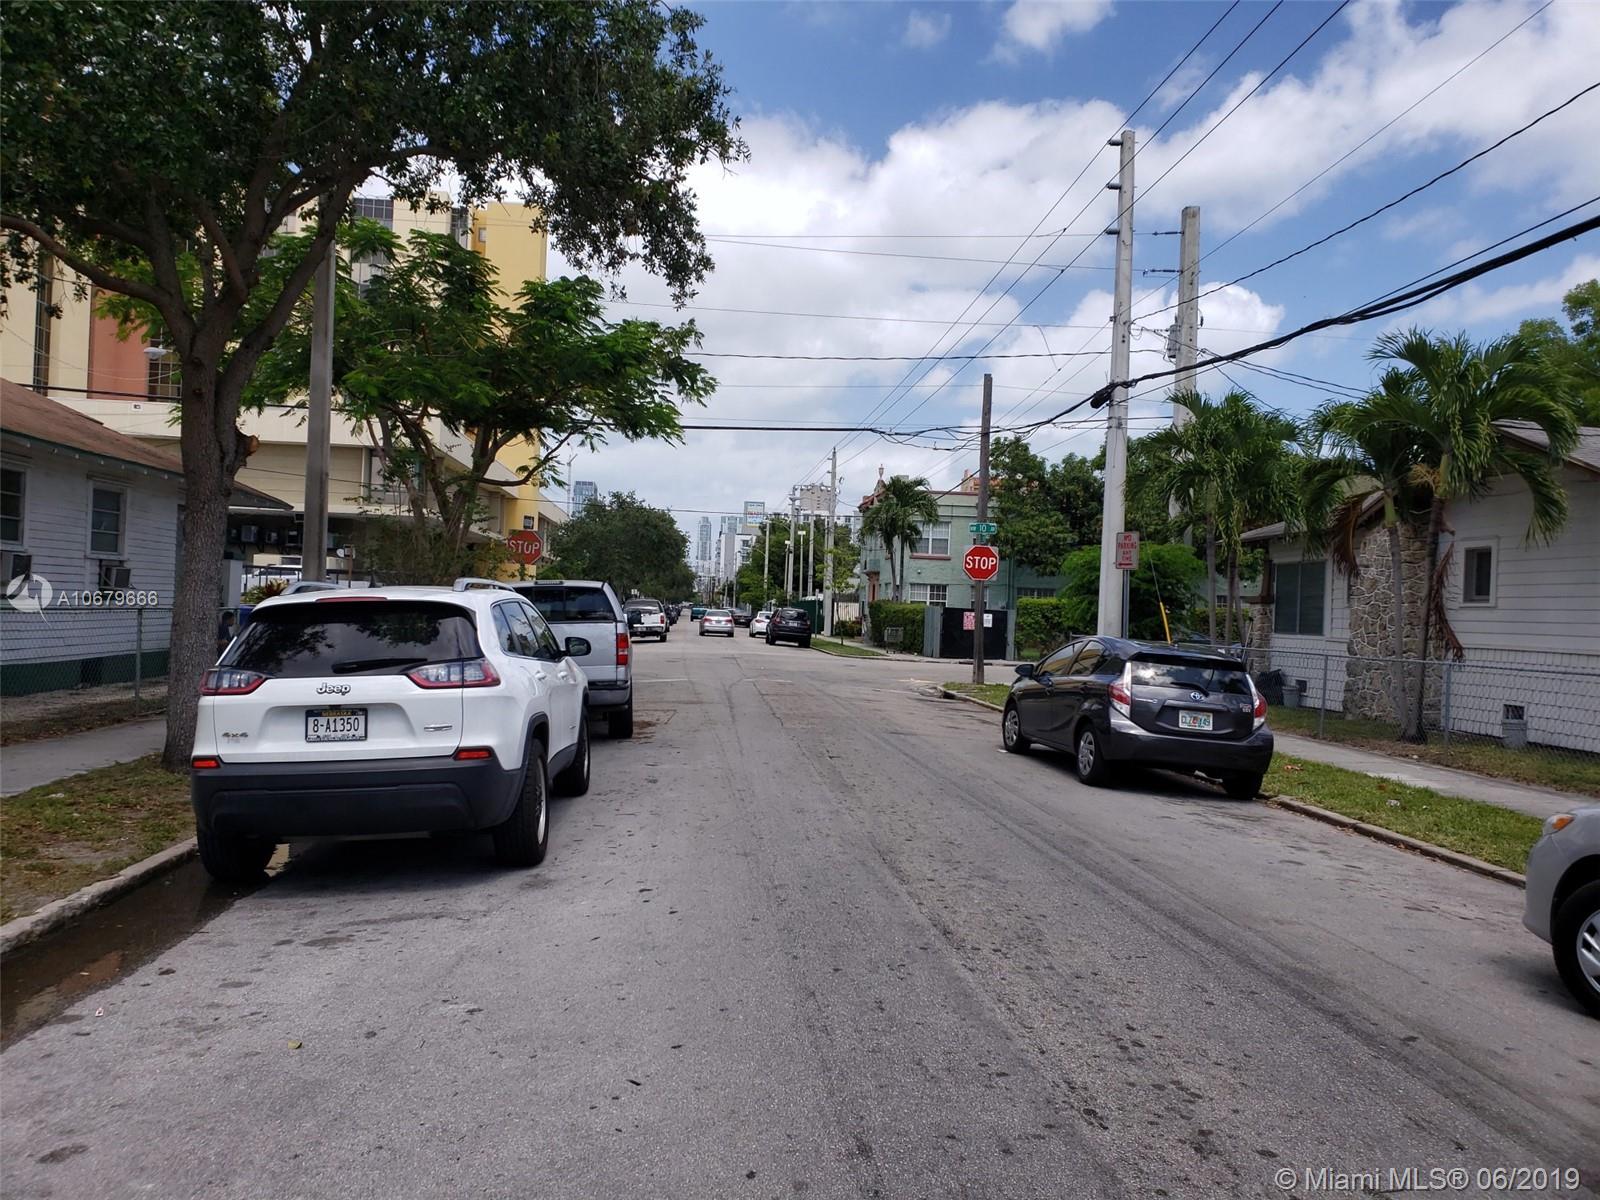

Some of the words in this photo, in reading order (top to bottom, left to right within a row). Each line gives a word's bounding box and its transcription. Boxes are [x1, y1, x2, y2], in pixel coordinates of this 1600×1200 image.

[980, 524, 986, 532] 10
[509, 539, 540, 554] STOP
[966, 556, 997, 570] STOP
[317, 682, 351, 696] Jeep
[313, 717, 360, 733] 8-A1350
